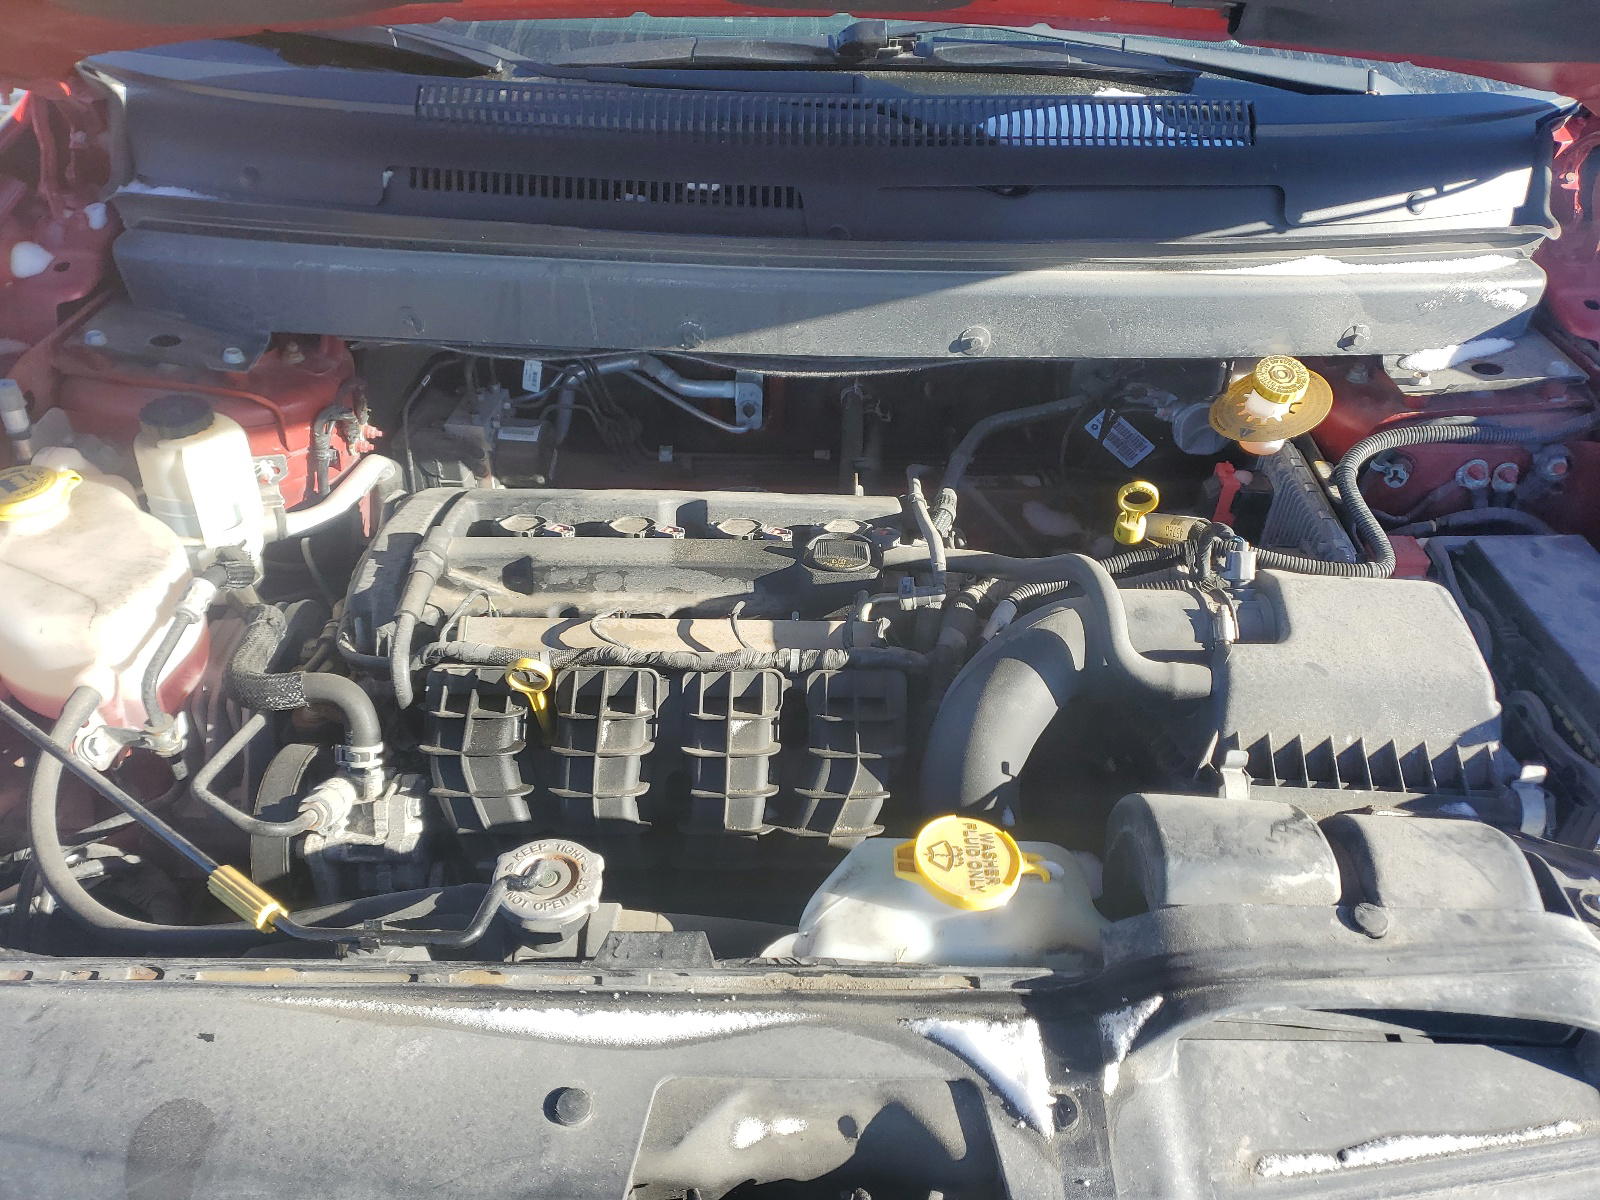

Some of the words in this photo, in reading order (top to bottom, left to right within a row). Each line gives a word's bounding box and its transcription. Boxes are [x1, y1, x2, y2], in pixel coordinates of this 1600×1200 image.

[512, 843, 547, 862] KEEP
[555, 843, 589, 862] TIGHT
[962, 822, 981, 857] FLUID
[979, 832, 1001, 886] WASHER
[966, 860, 987, 893] ONLY
[505, 890, 529, 908] NOT
[533, 896, 571, 911] OPEN
